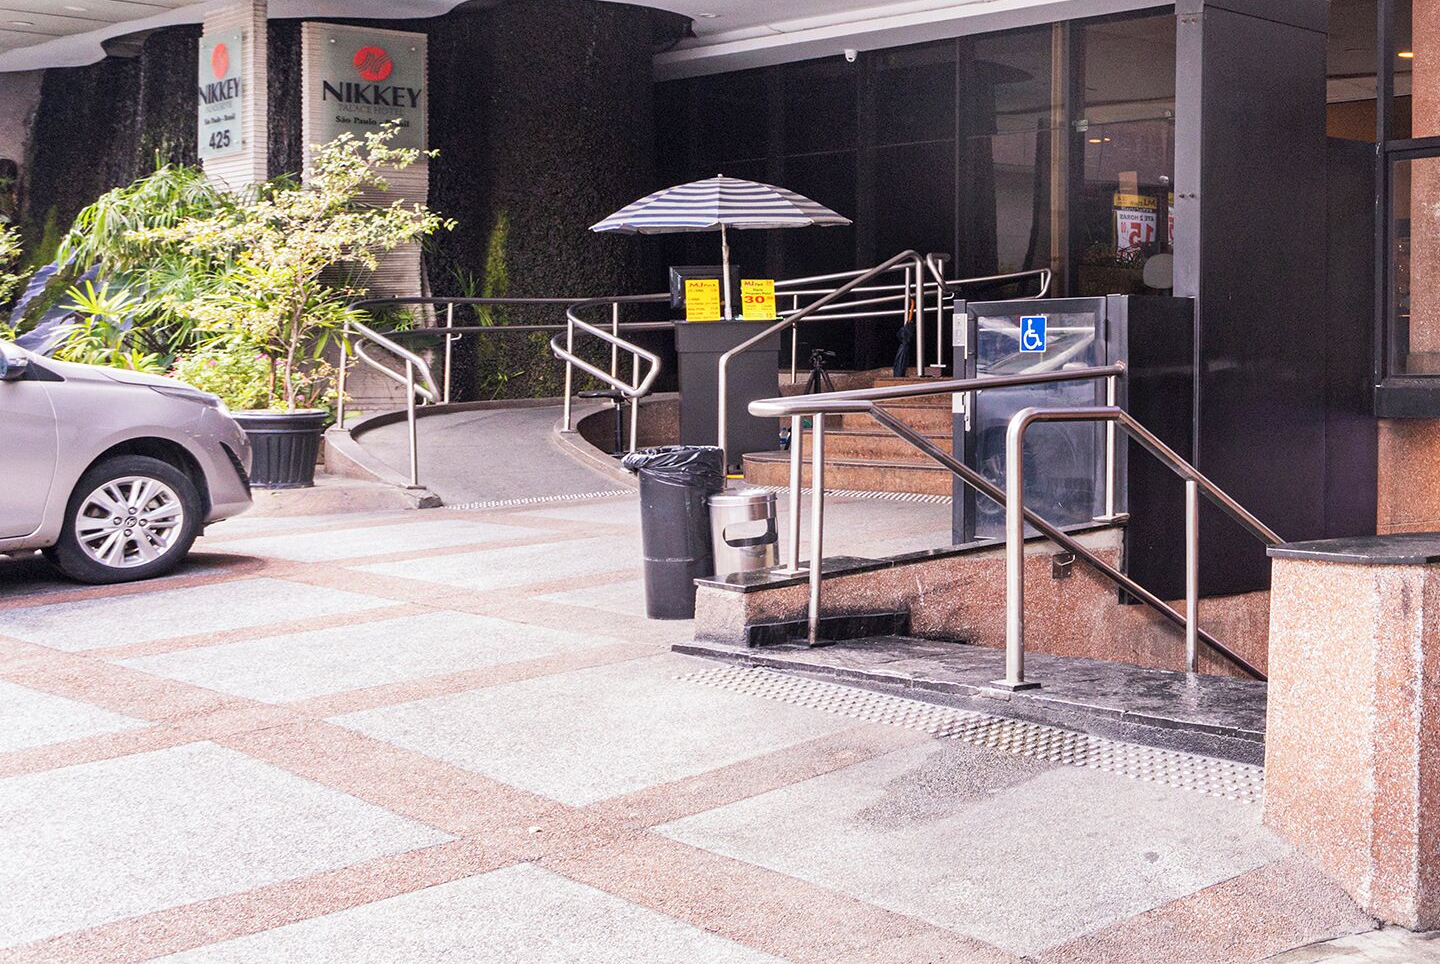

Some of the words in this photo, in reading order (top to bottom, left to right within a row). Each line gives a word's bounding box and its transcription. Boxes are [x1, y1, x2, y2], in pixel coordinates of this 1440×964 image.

[199, 77, 241, 105] NIKKEY
[323, 80, 422, 108] NIKKEY
[335, 115, 352, 124] São
[353, 117, 377, 126] Paulo
[209, 129, 231, 150] 425
[744, 296, 765, 304] 30
